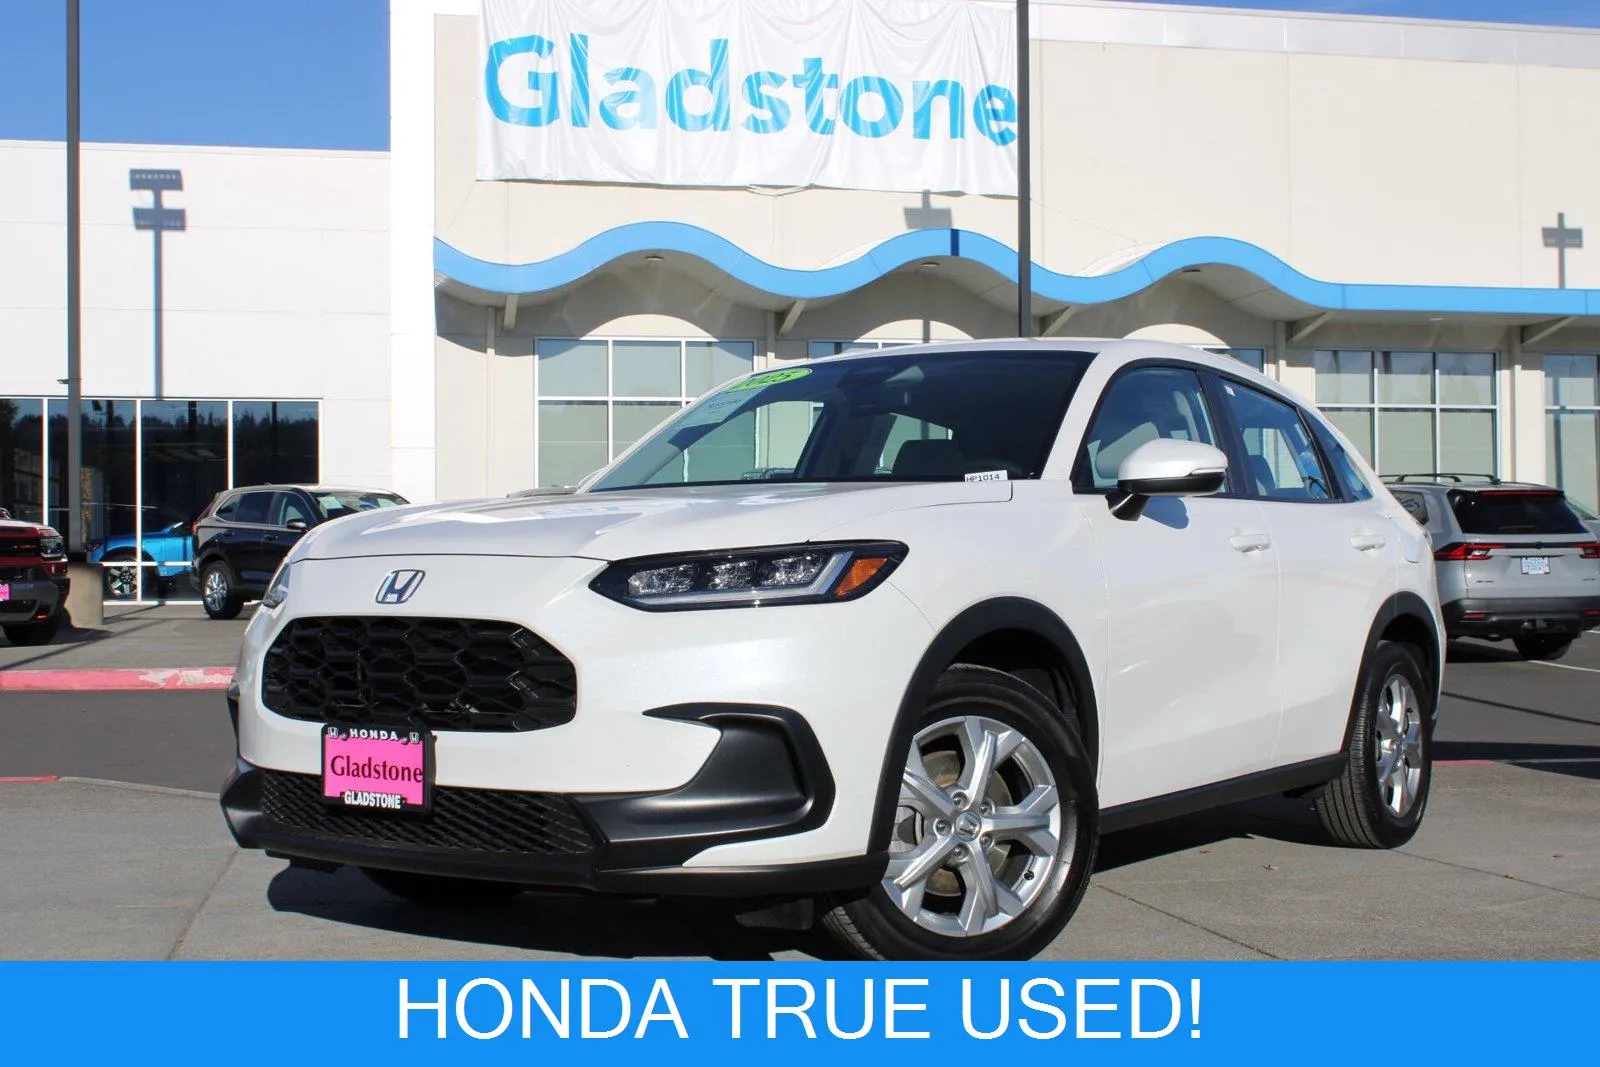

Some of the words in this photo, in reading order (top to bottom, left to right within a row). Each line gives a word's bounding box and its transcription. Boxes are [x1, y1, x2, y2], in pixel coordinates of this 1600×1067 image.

[484, 33, 1018, 146] Gladstone
[349, 728, 398, 741] HONDA
[330, 755, 424, 783] Gladstone
[344, 790, 401, 809] GLADSTONE
